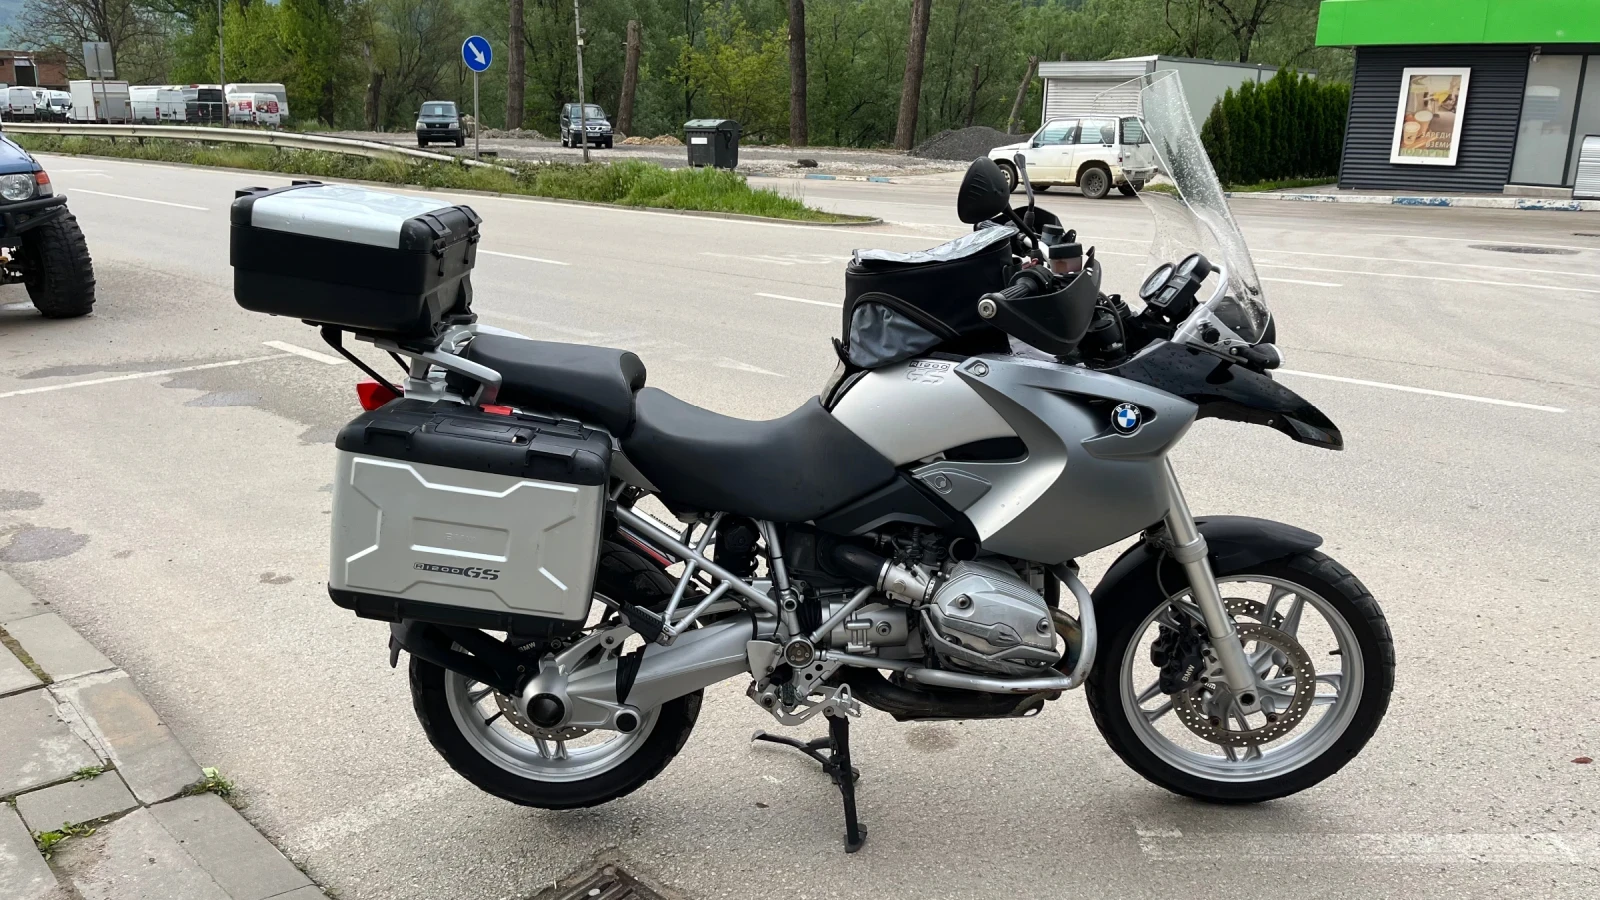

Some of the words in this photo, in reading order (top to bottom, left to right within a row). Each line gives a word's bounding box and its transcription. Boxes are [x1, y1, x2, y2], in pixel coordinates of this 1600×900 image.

[1115, 404, 1140, 415] BMW
[518, 641, 536, 652] BMW
[1181, 664, 1195, 683] BMW
